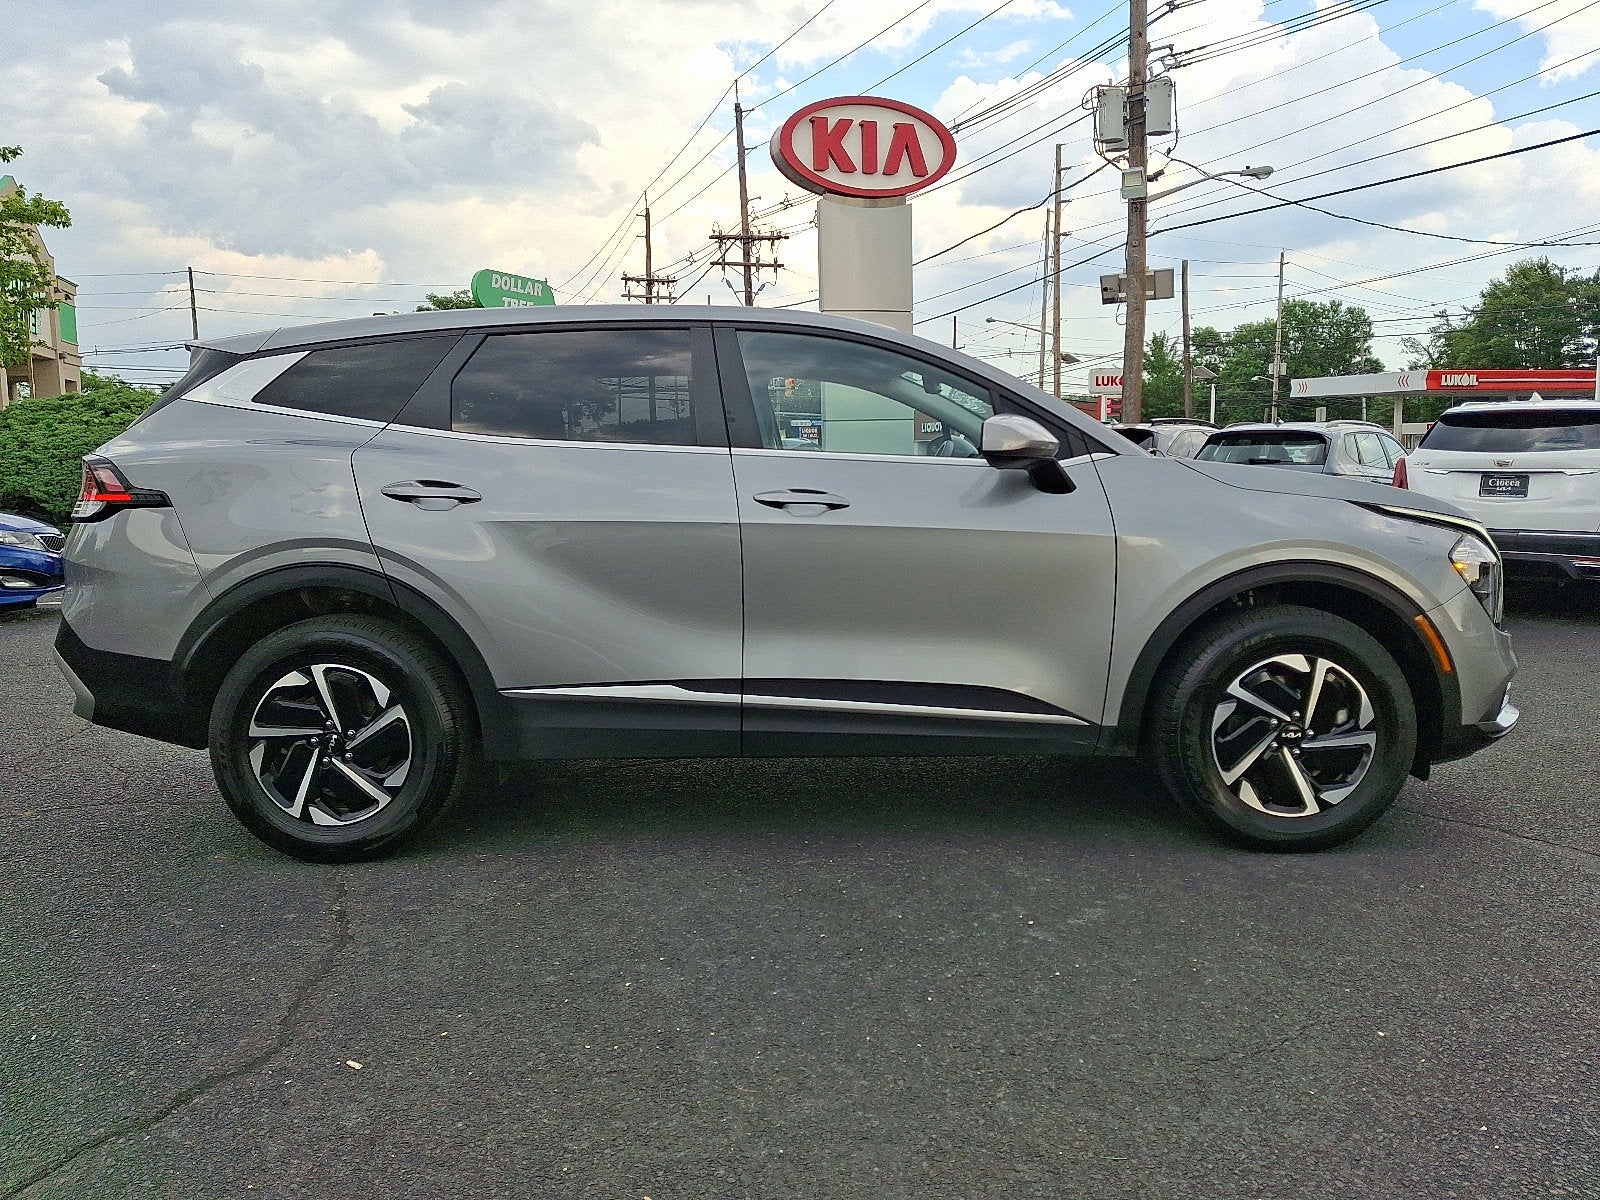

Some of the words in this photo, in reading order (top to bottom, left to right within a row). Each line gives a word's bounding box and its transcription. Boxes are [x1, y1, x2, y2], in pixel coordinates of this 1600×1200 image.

[808, 115, 929, 178] KIA
[491, 273, 543, 297] DOLLAR
[1440, 372, 1479, 387] LUKOIL
[1488, 478, 1520, 487] Ciocca
